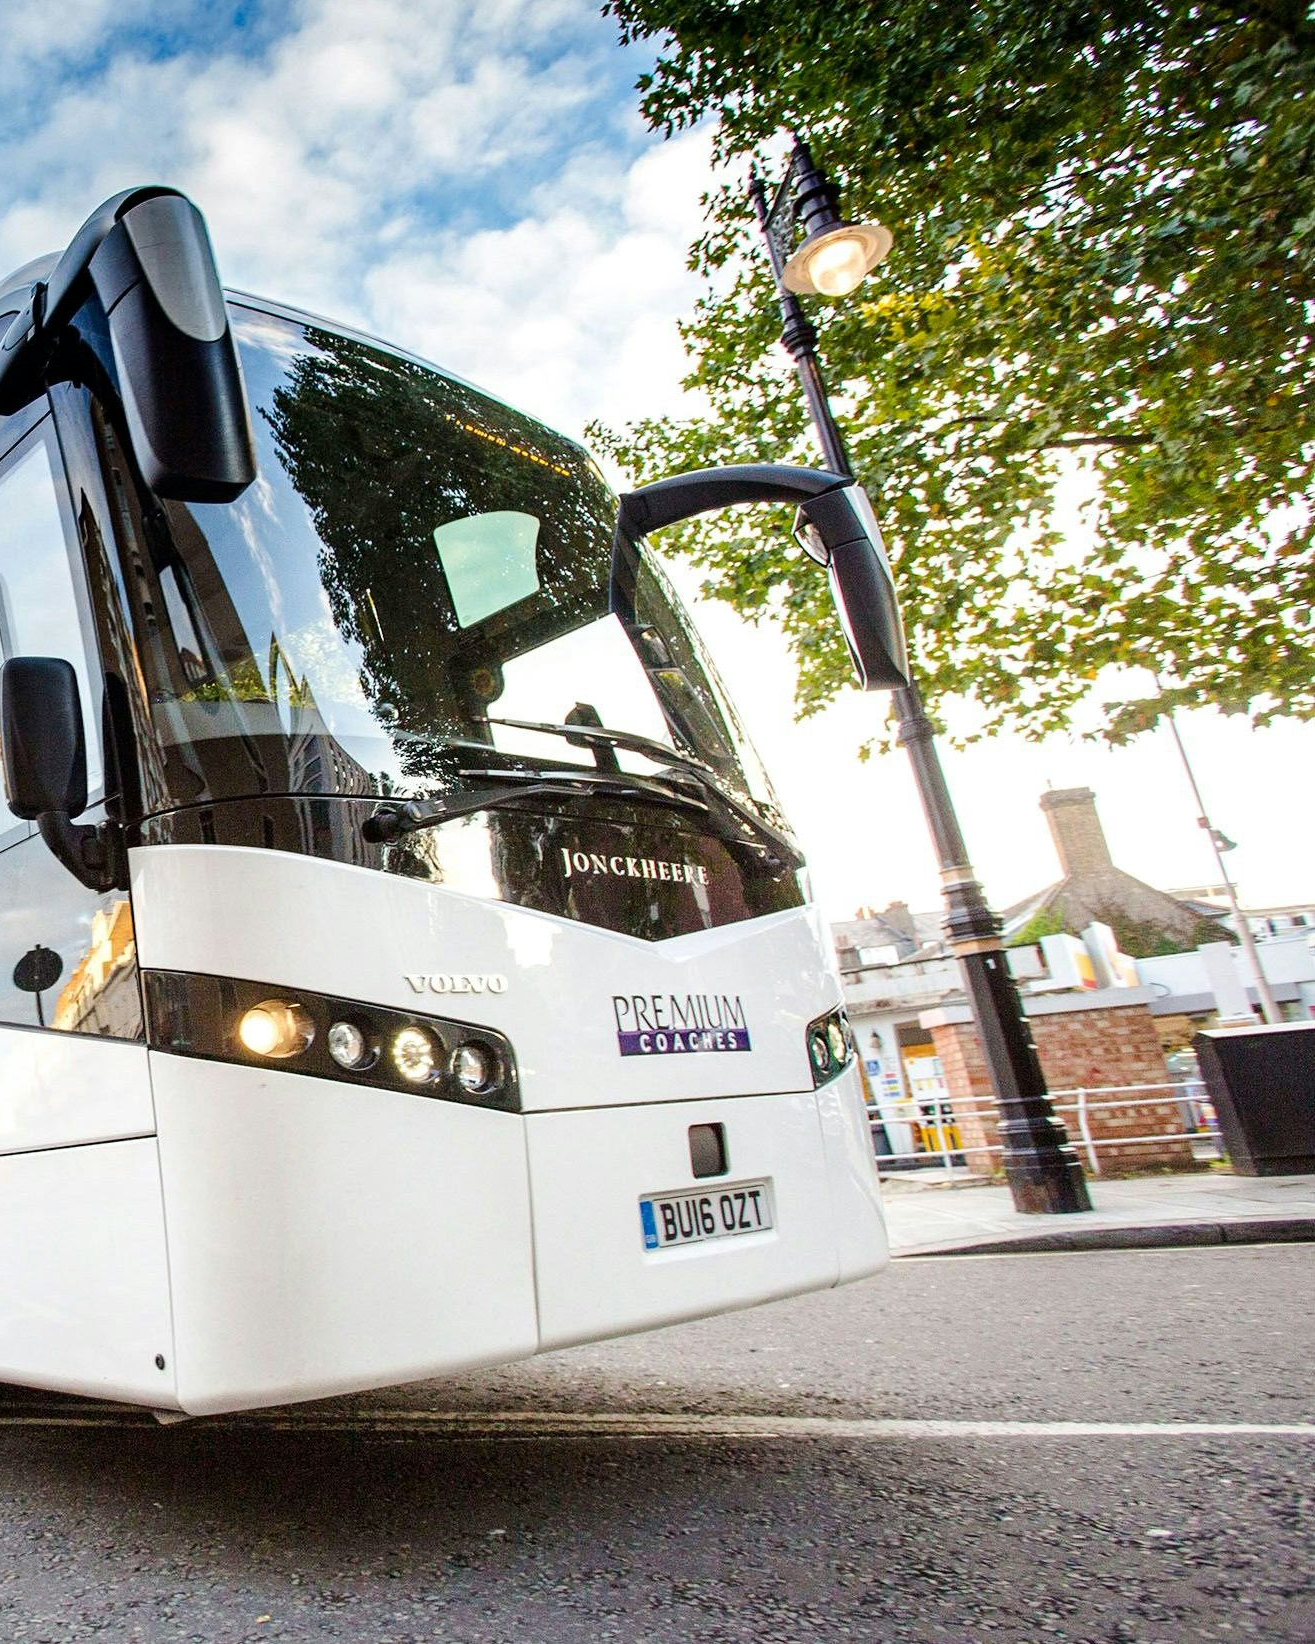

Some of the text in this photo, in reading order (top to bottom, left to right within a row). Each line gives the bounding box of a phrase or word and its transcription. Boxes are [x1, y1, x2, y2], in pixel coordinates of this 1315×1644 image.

[560, 847, 709, 887] JONCKHEERE
[403, 973, 509, 995] VOLVO
[611, 994, 747, 1033] PREMIUM
[639, 1031, 738, 1052] COACHES
[659, 1189, 762, 1242] BU16 OZT
